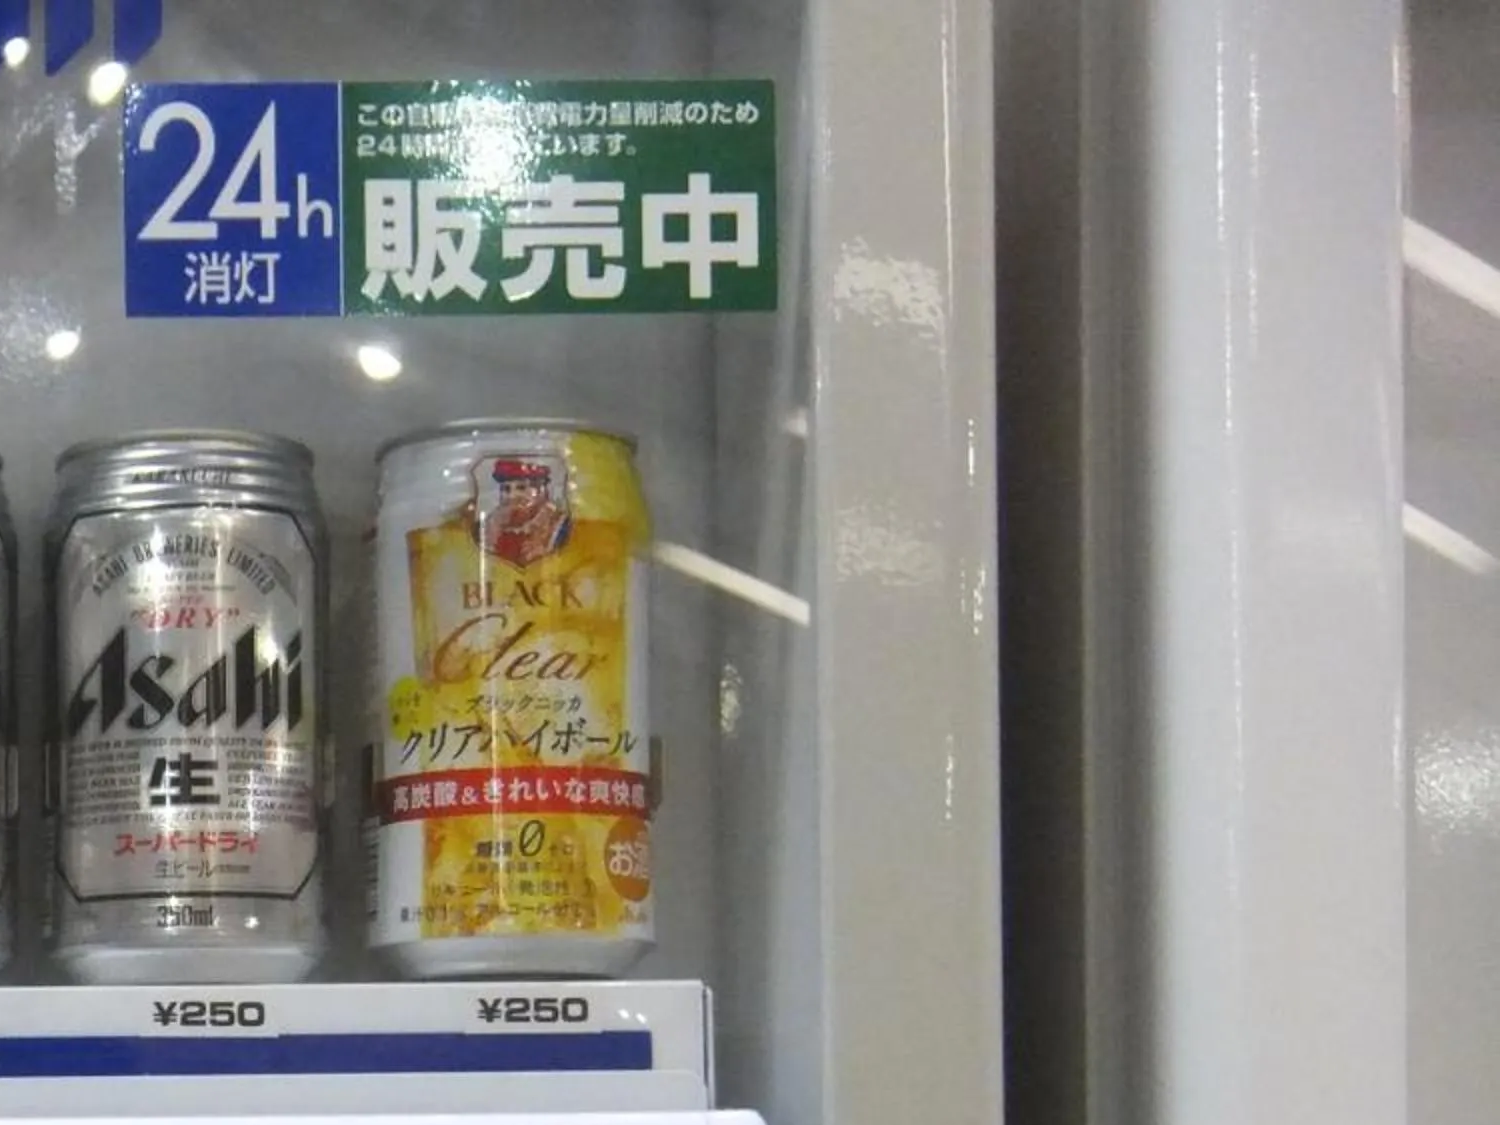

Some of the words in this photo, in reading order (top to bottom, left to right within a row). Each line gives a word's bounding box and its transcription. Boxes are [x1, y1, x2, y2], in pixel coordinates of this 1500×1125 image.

[137, 101, 333, 240] 24h
[361, 173, 759, 300] 販売中
[184, 252, 279, 304] 消灯
[463, 581, 584, 609] BLACK
[432, 612, 610, 686] Clear
[69, 624, 303, 739] Asahi
[400, 717, 639, 765] クリアハイボール
[149, 752, 221, 806] 生
[114, 831, 260, 856] スーパードライ
[153, 1001, 265, 1027] ¥250
[477, 998, 589, 1023] ¥250
